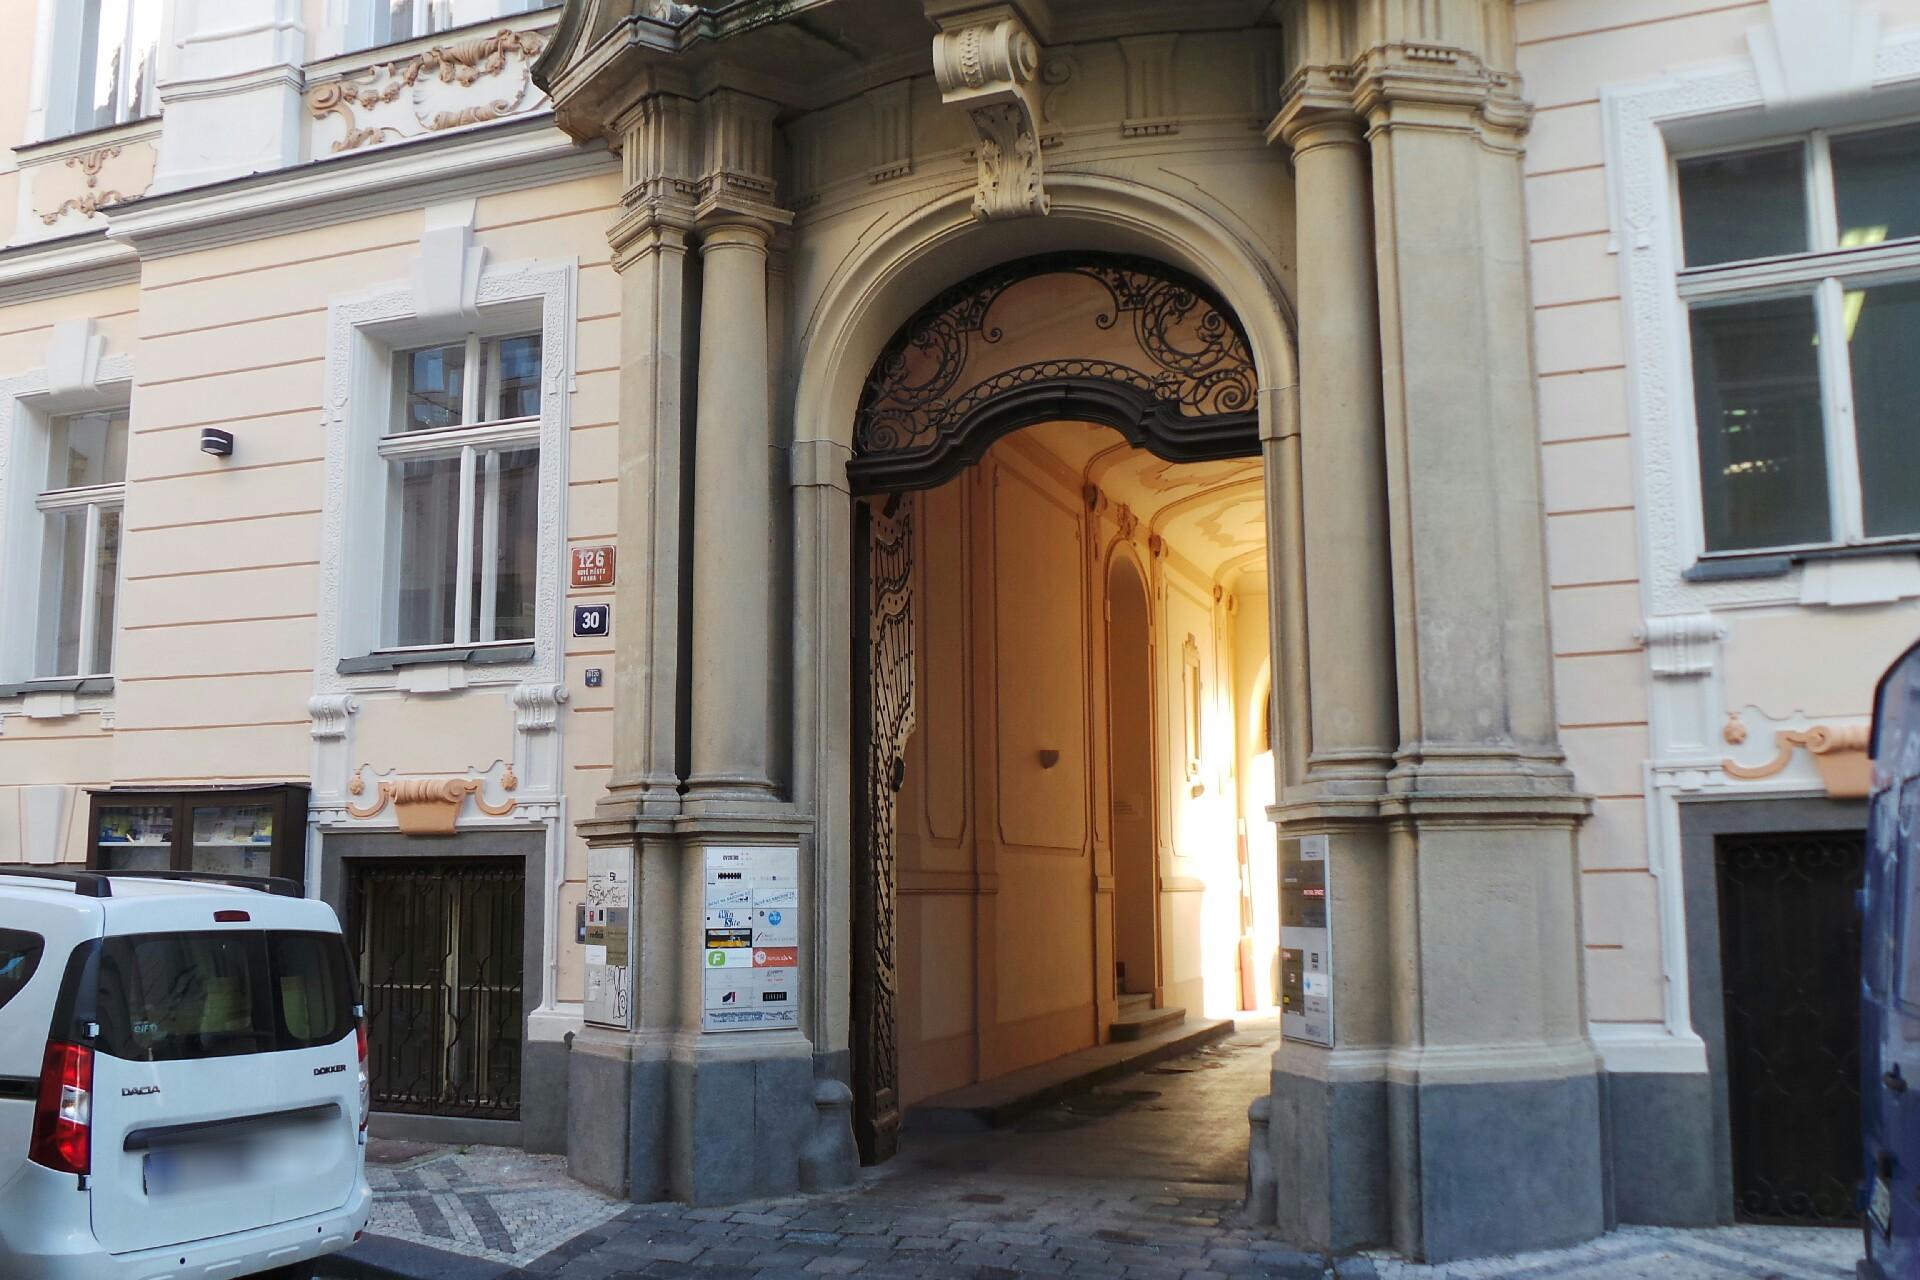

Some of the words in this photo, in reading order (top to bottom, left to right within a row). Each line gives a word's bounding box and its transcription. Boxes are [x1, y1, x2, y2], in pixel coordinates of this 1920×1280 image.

[578, 550, 605, 568] 126
[582, 612, 600, 629] 30
[313, 1064, 346, 1076] DOKKER
[121, 1085, 161, 1097] DACIA
